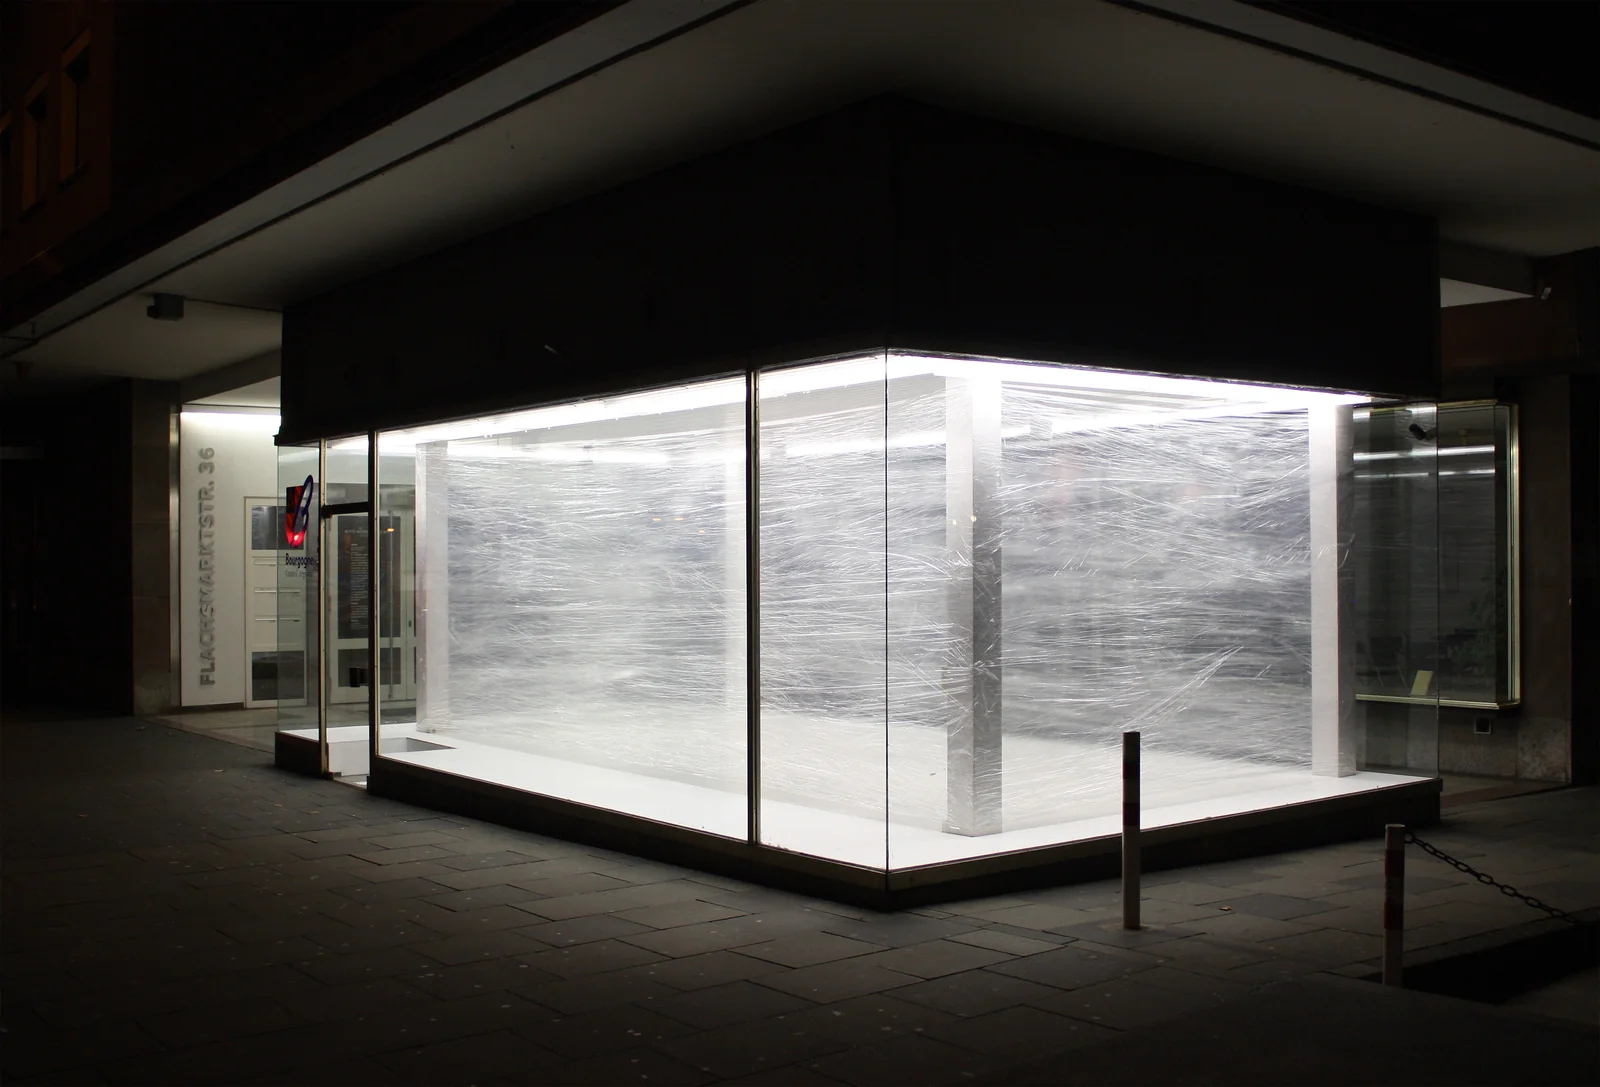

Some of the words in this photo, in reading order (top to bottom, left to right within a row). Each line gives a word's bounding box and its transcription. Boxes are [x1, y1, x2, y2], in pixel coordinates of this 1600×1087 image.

[199, 447, 216, 474] 36
[285, 552, 313, 569] Bourgogne
[199, 480, 216, 686] FLACHSMARKTSTR.
